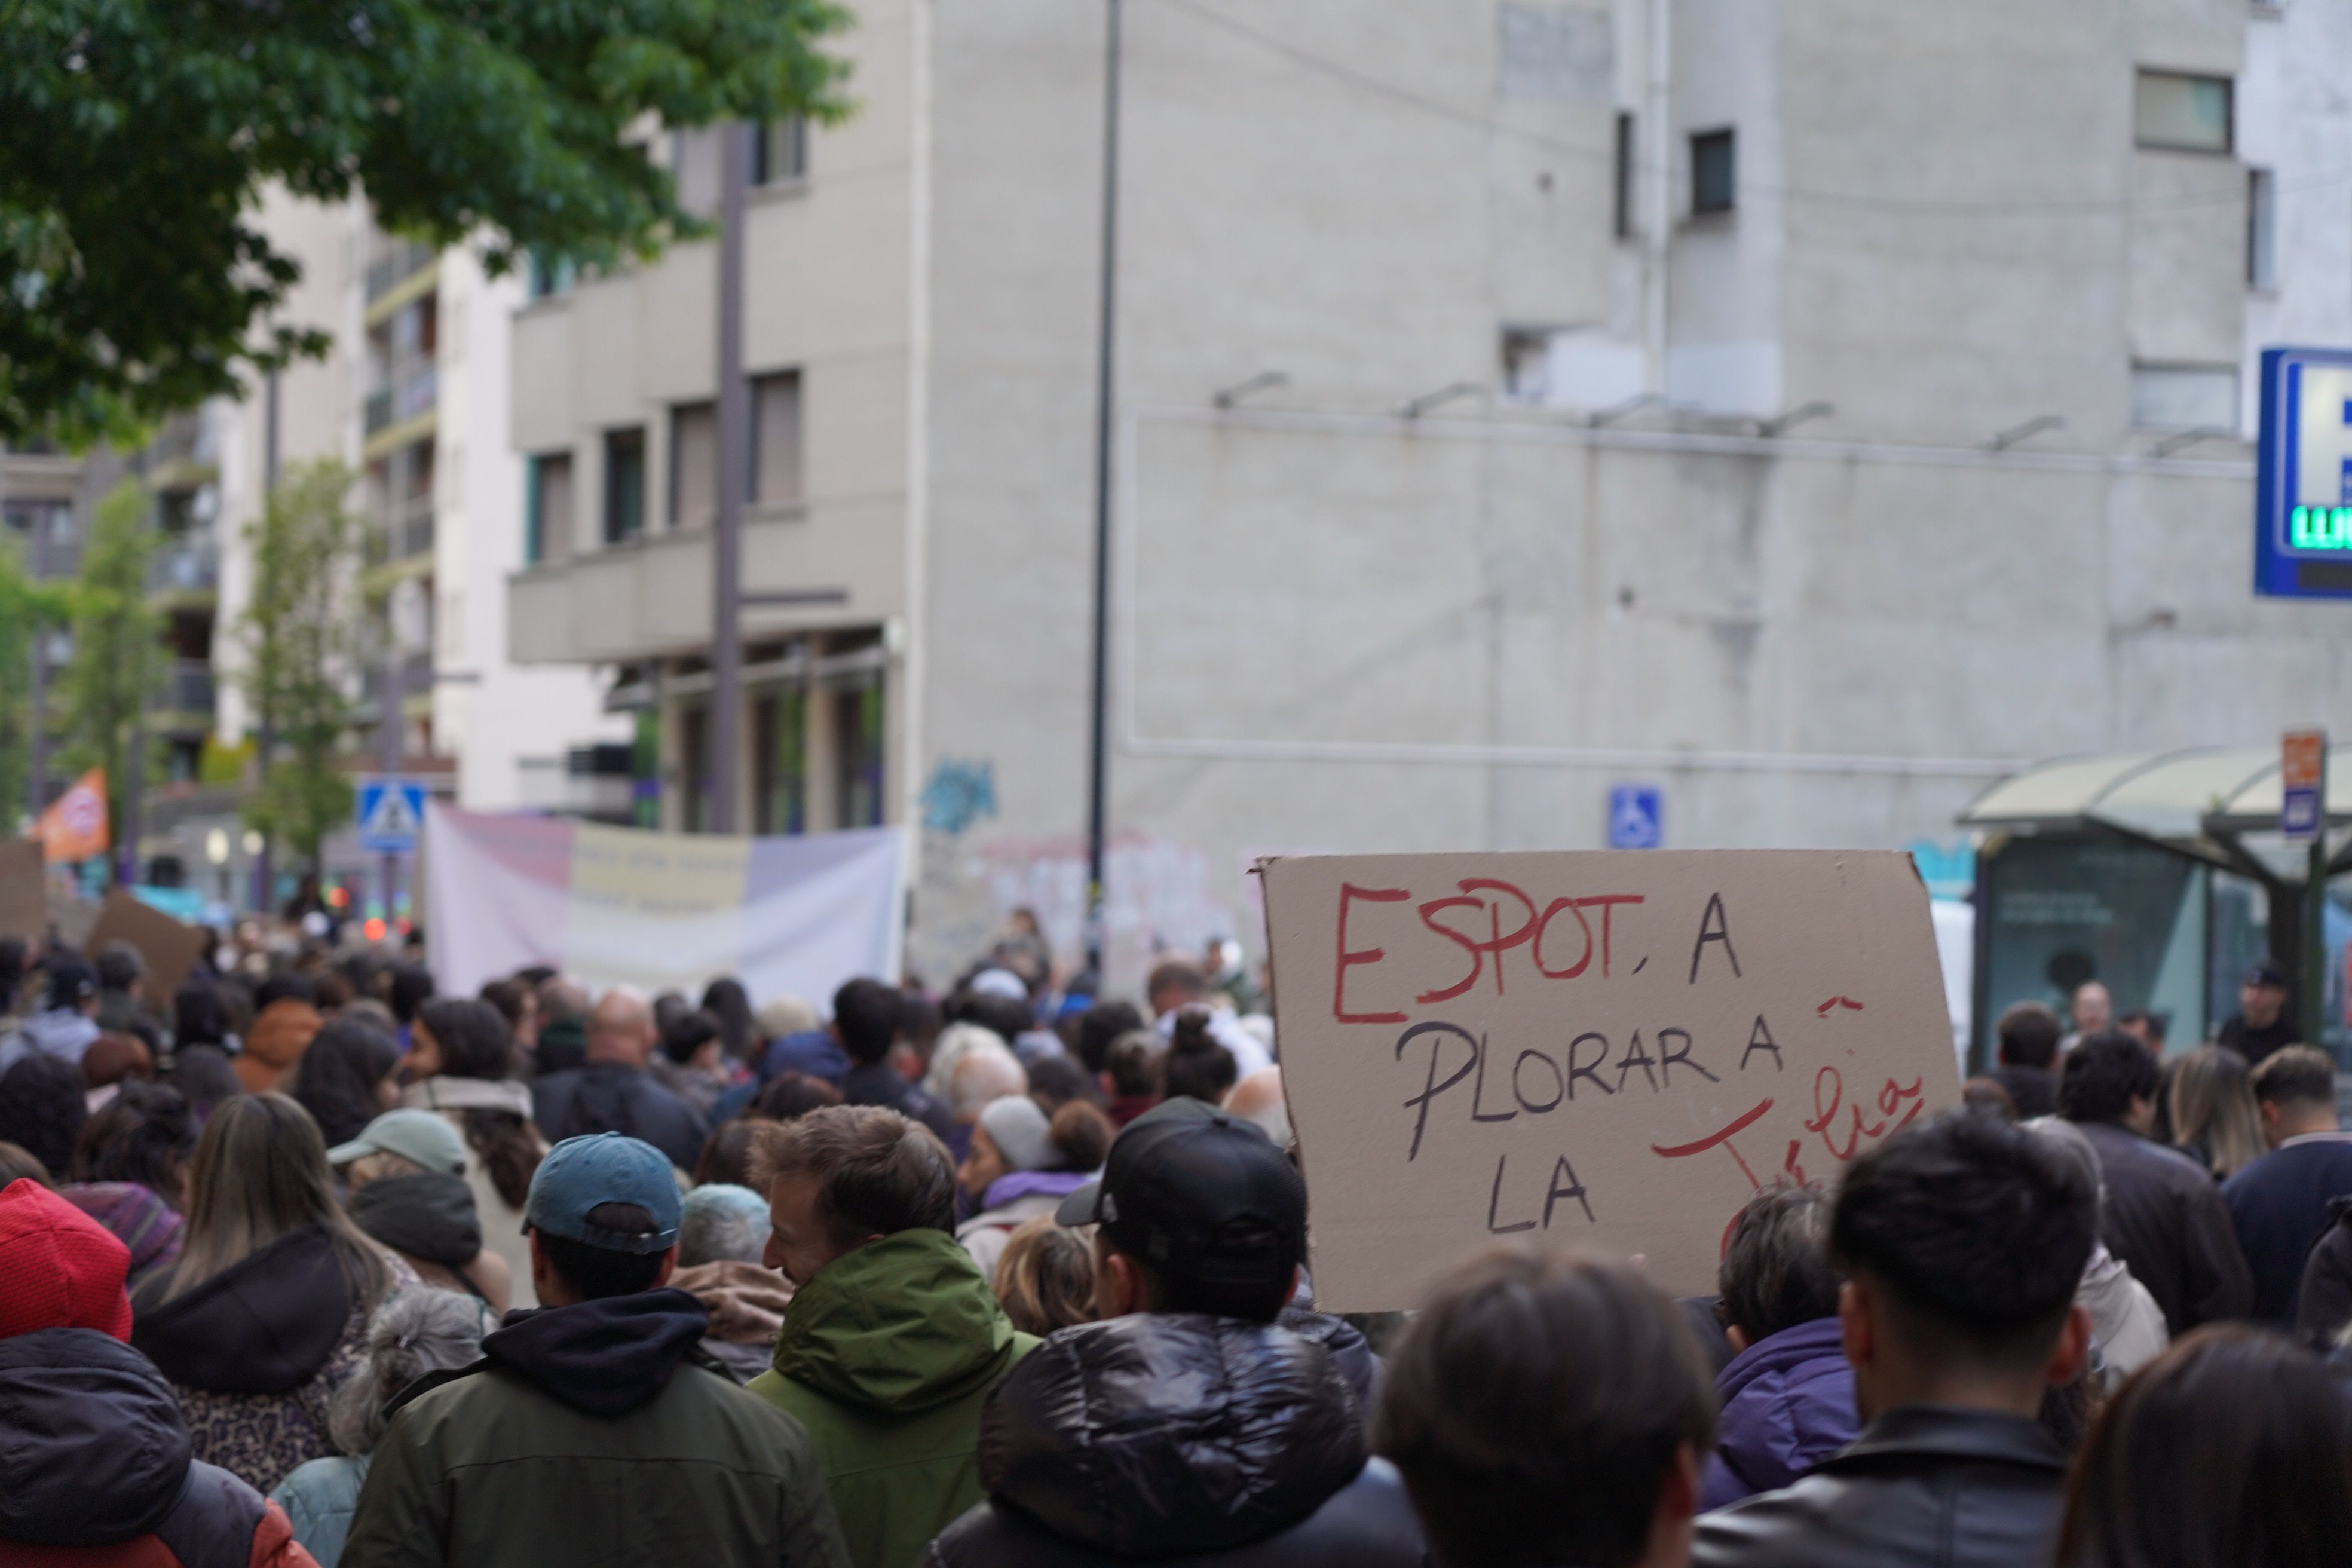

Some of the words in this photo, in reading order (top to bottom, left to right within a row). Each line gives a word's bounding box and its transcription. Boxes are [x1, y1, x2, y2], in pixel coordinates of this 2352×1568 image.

[1333, 877, 1649, 1024] ESPOT,
[1689, 892, 1742, 985] A
[1395, 1021, 1721, 1162] PLORAR
[1739, 1013, 1784, 1072] A
[1487, 1154, 1597, 1235] LA
